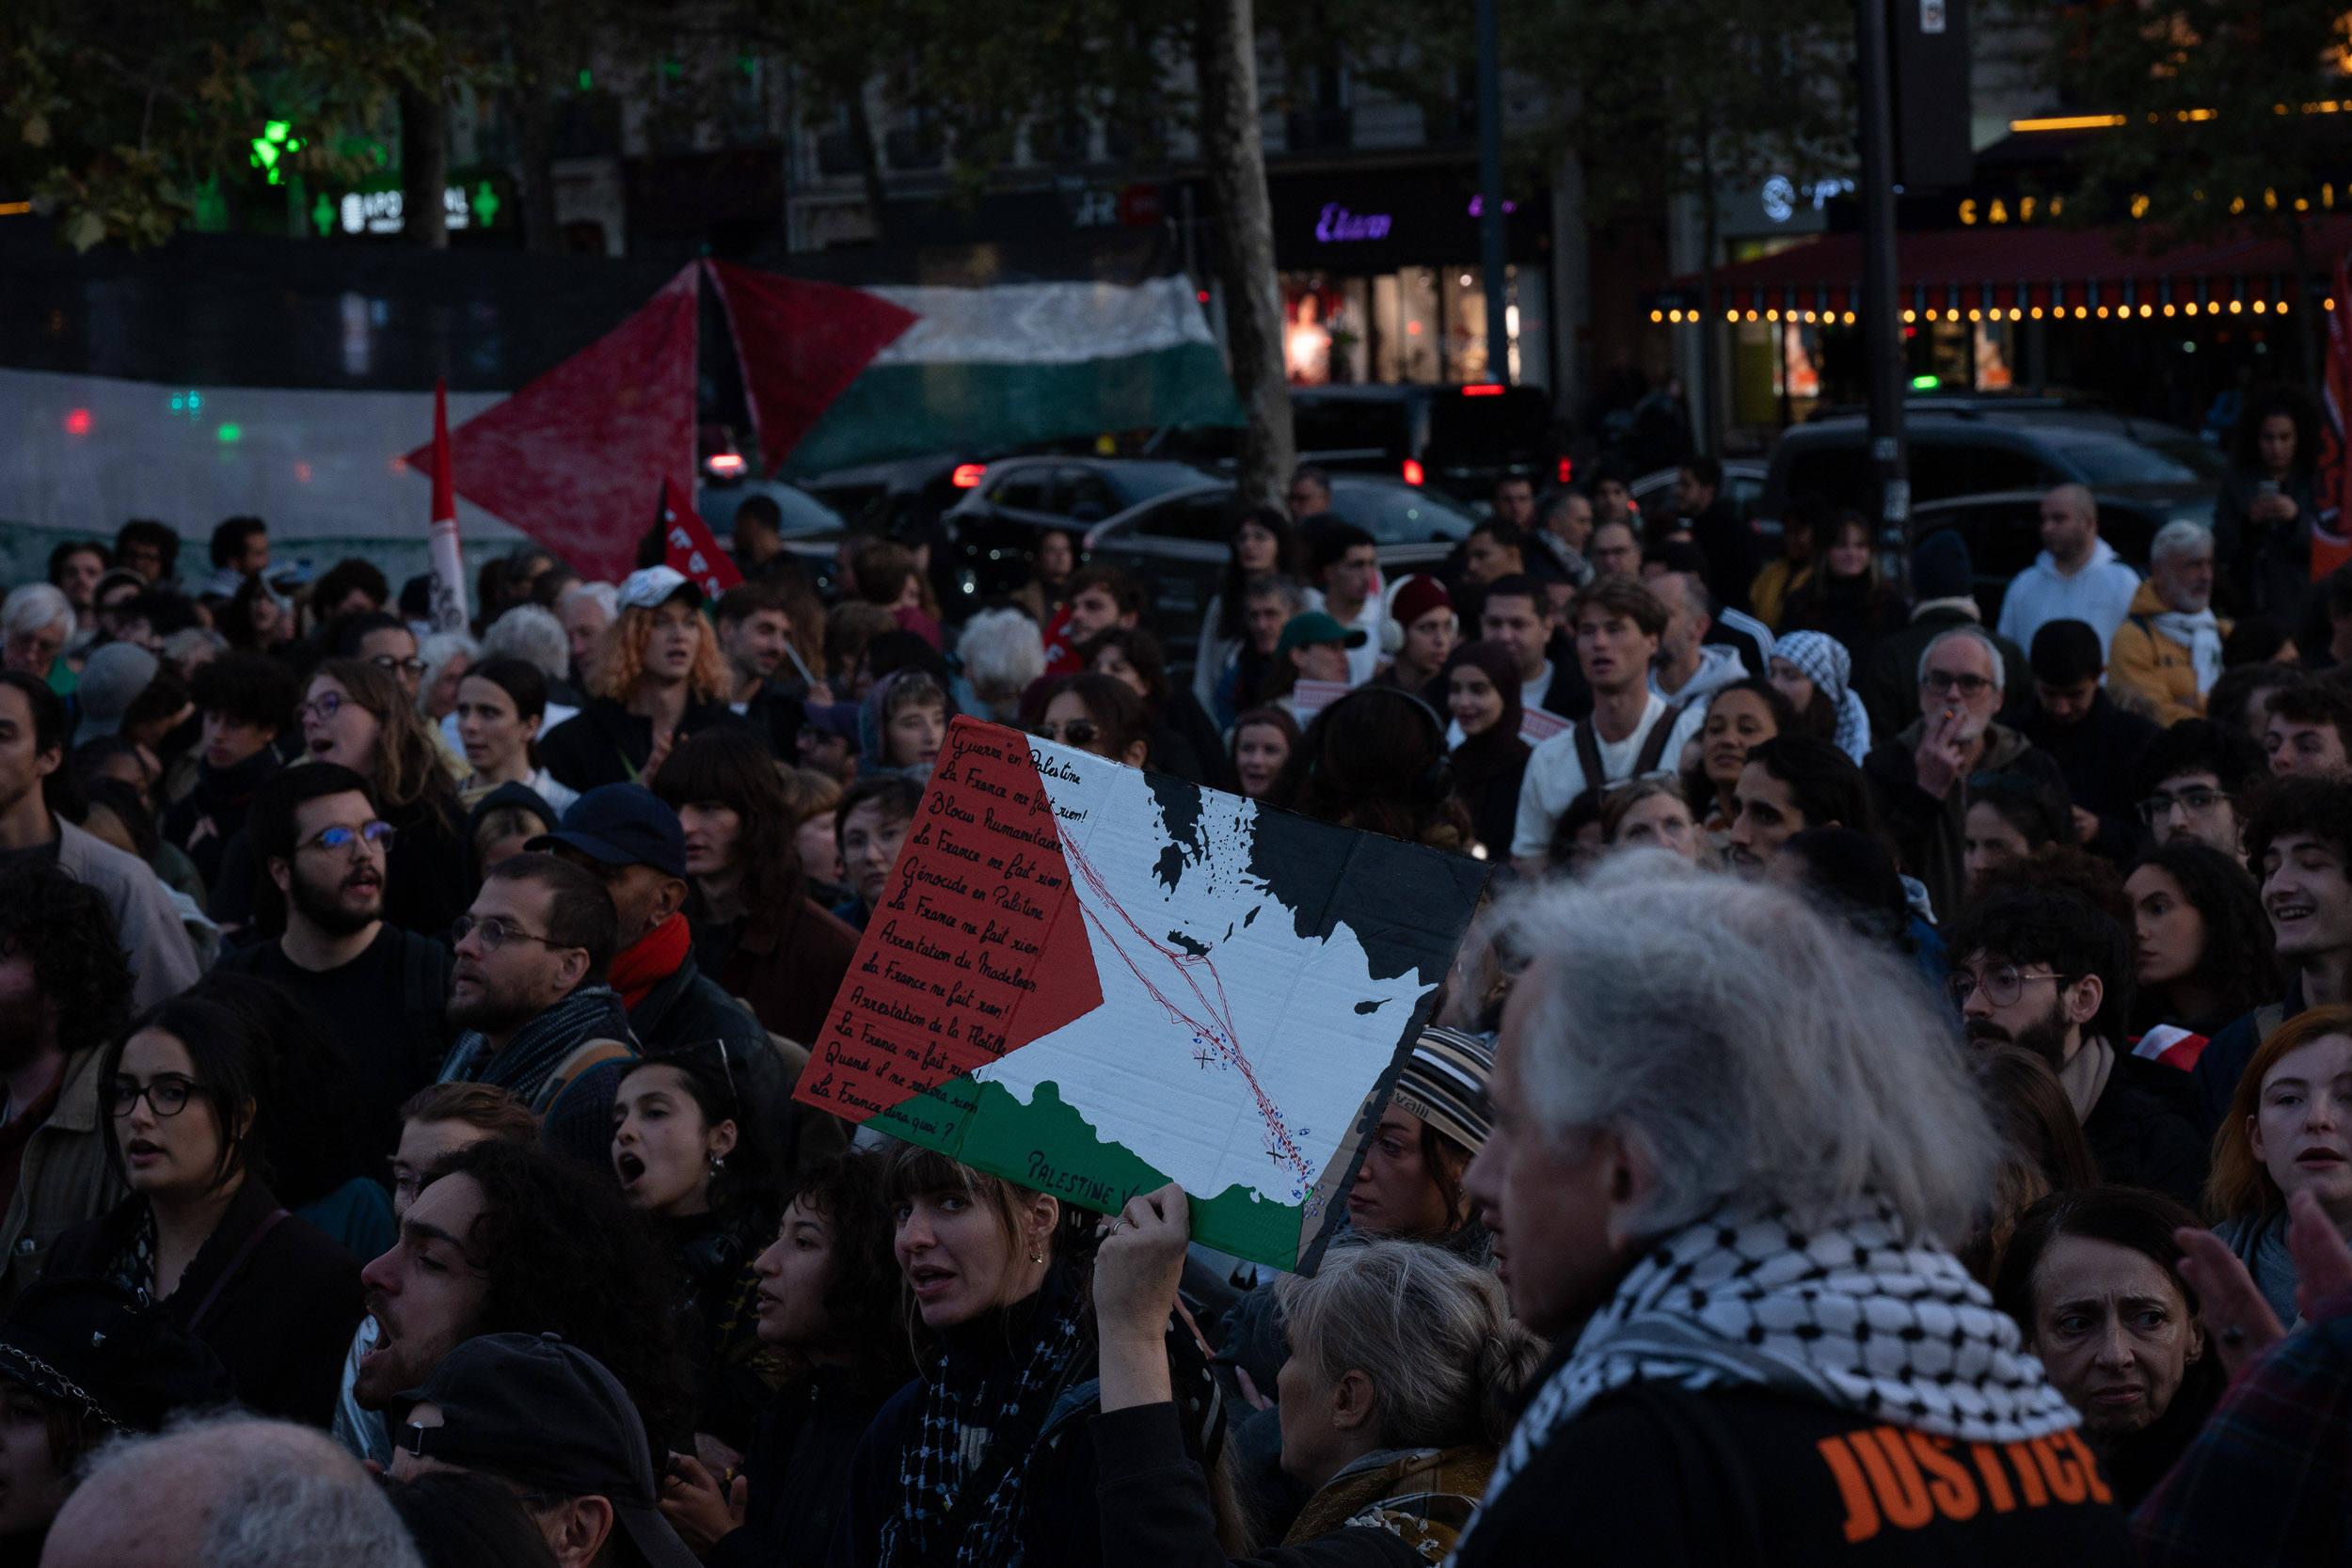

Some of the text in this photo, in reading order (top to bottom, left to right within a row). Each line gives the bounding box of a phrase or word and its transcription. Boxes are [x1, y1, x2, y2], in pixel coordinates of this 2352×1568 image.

[939, 761, 958, 782] La
[964, 768, 1007, 798] France
[1029, 789, 1055, 816] fait
[1008, 753, 1022, 766] en
[1027, 749, 1080, 784] Palestine
[914, 823, 930, 846] La
[937, 830, 980, 863] France
[1003, 852, 1037, 879] fait
[929, 791, 1063, 854] Blocus humanitaire
[887, 887, 906, 911] La
[914, 895, 957, 927] France
[979, 919, 1009, 944] fait
[902, 857, 1043, 921] Génocide en Palestine
[862, 951, 879, 974] La
[885, 960, 927, 990] France
[946, 981, 974, 1007] fait
[880, 919, 1037, 992] Arrestation du Madeleen
[835, 1011, 852, 1037] La
[861, 1023, 898, 1054] France
[921, 1041, 948, 1070] fait
[850, 986, 926, 1026] Arrestation
[929, 1017, 943, 1033] de
[947, 1016, 959, 1038] la
[810, 1072, 955, 1141] La France dira quoi ?
[826, 1041, 871, 1071] Quand
[876, 1061, 890, 1078] il
[950, 1096, 977, 1114] rien
